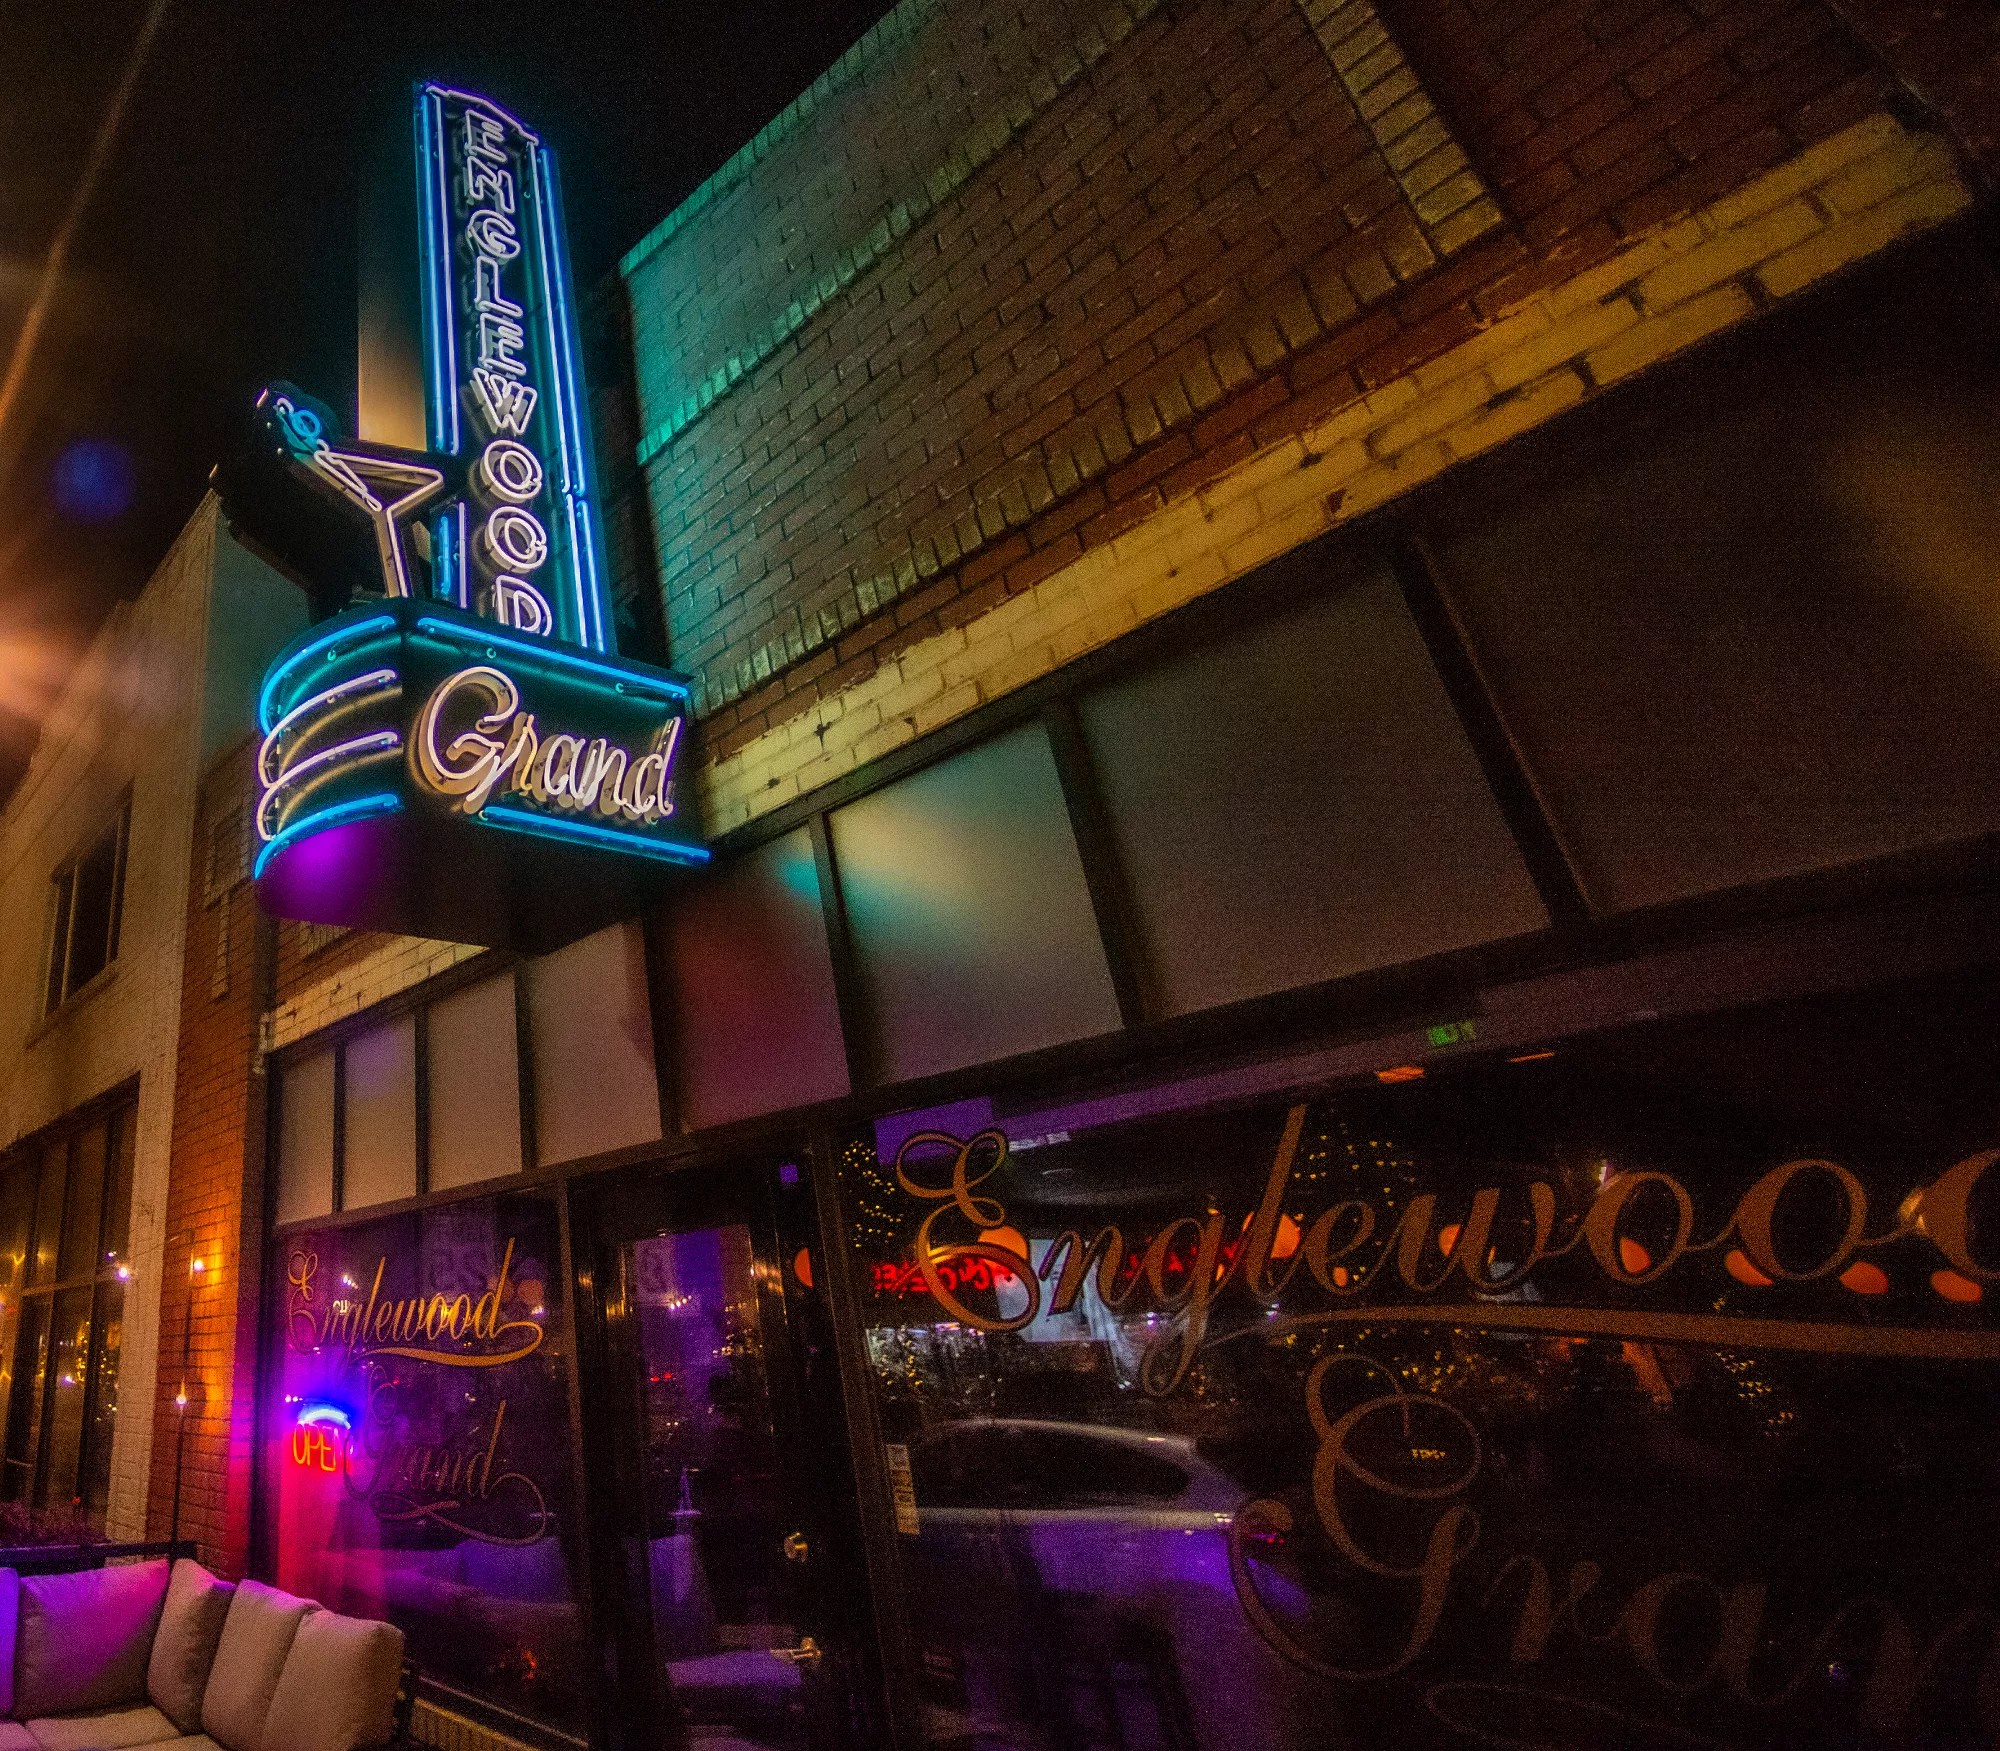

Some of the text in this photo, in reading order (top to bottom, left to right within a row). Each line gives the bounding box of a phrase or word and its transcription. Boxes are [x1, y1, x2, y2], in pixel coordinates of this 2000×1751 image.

[465, 108, 553, 637] ENGLEWOOD
[420, 666, 682, 820] Grand
[287, 1236, 544, 1378] Englewood
